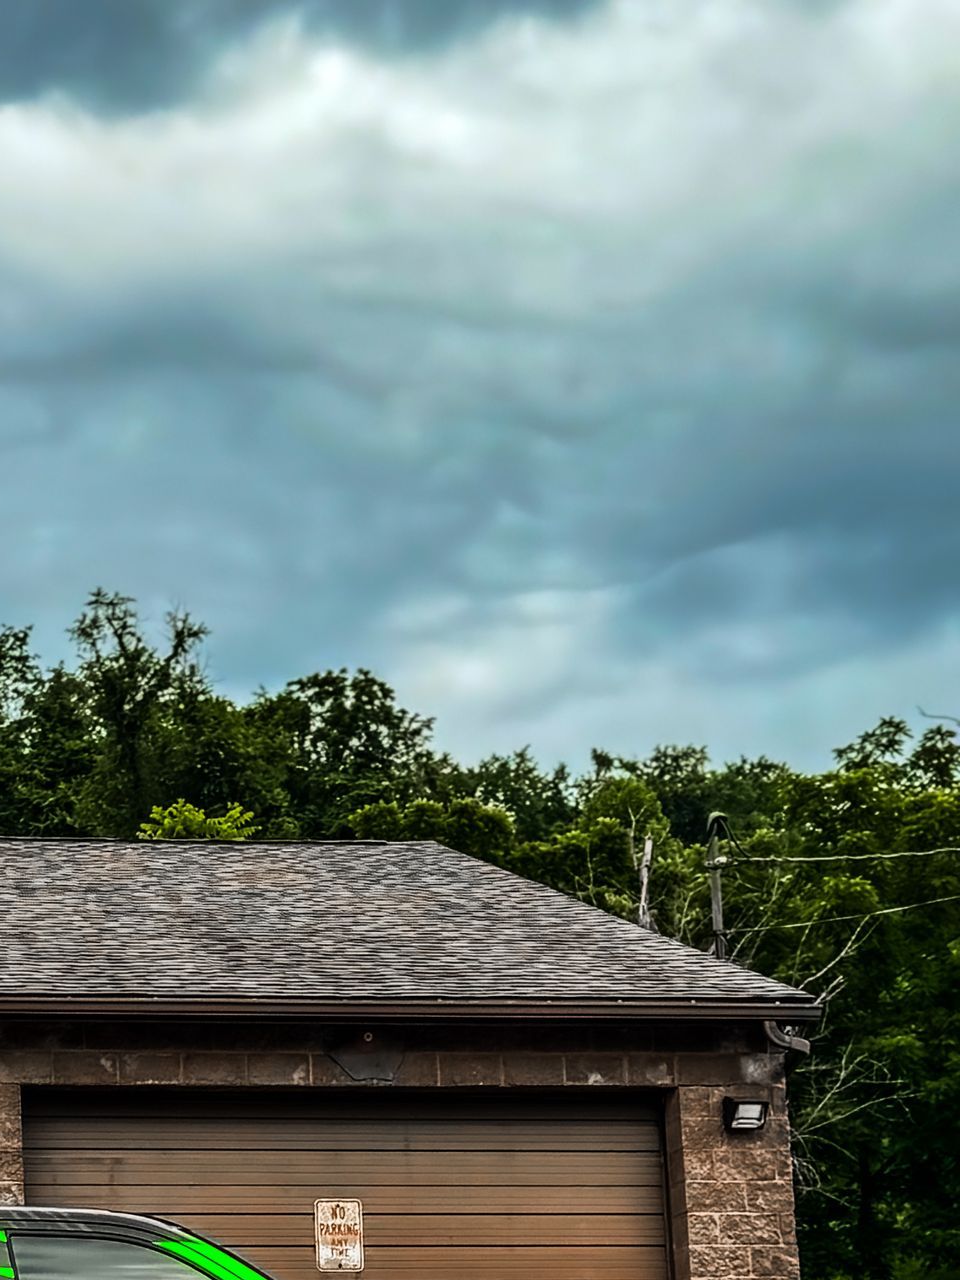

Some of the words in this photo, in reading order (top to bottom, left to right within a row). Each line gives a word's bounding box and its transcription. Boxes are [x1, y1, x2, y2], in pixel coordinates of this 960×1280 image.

[331, 1207, 346, 1220] NO
[320, 1223, 359, 1236] PARKING
[331, 1238, 349, 1247] ANY
